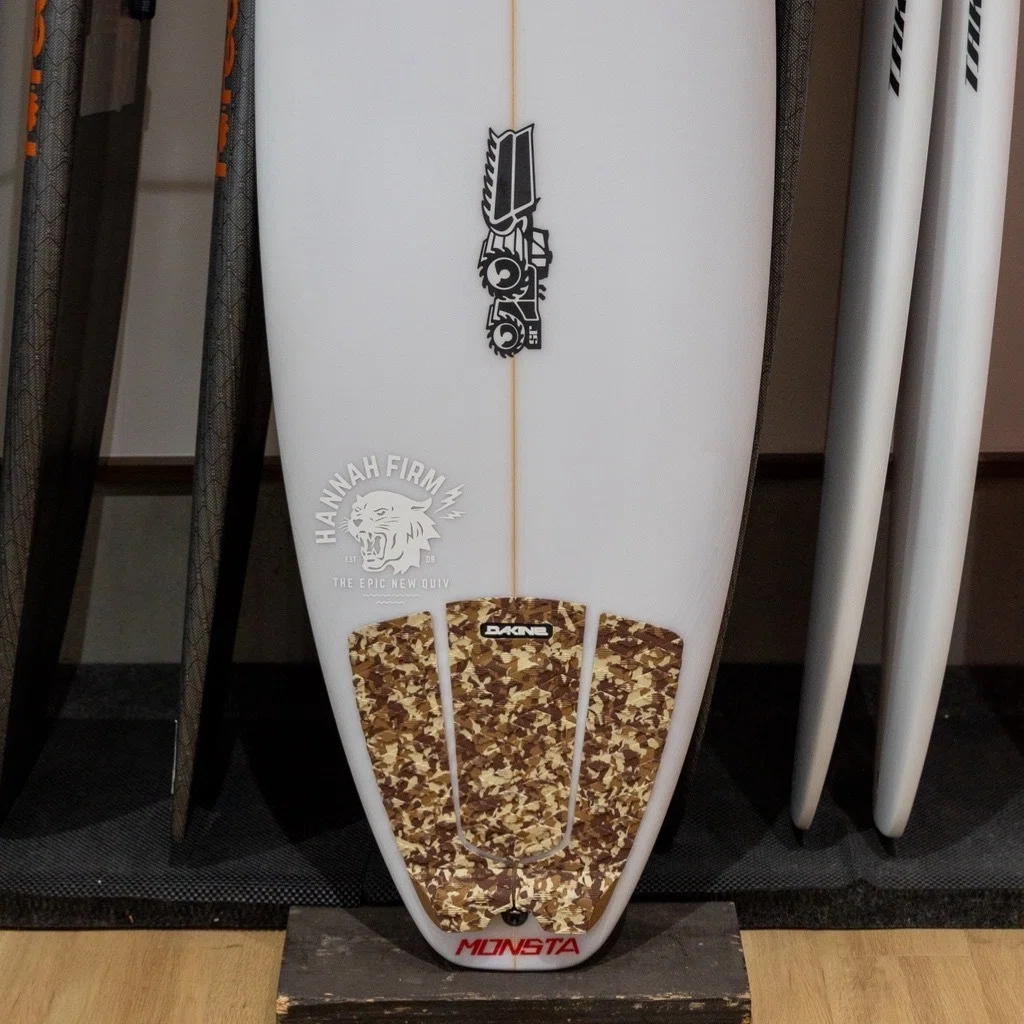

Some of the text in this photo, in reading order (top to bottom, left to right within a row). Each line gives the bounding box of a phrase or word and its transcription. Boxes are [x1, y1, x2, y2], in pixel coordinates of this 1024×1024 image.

[528, 326, 538, 345] JS
[315, 454, 446, 544] HANNAH FIRM
[345, 555, 356, 563] EST
[333, 578, 450, 589] THE EPIC NEW QUIV
[485, 625, 549, 636] DAKINE
[455, 937, 580, 956] MONSTA
